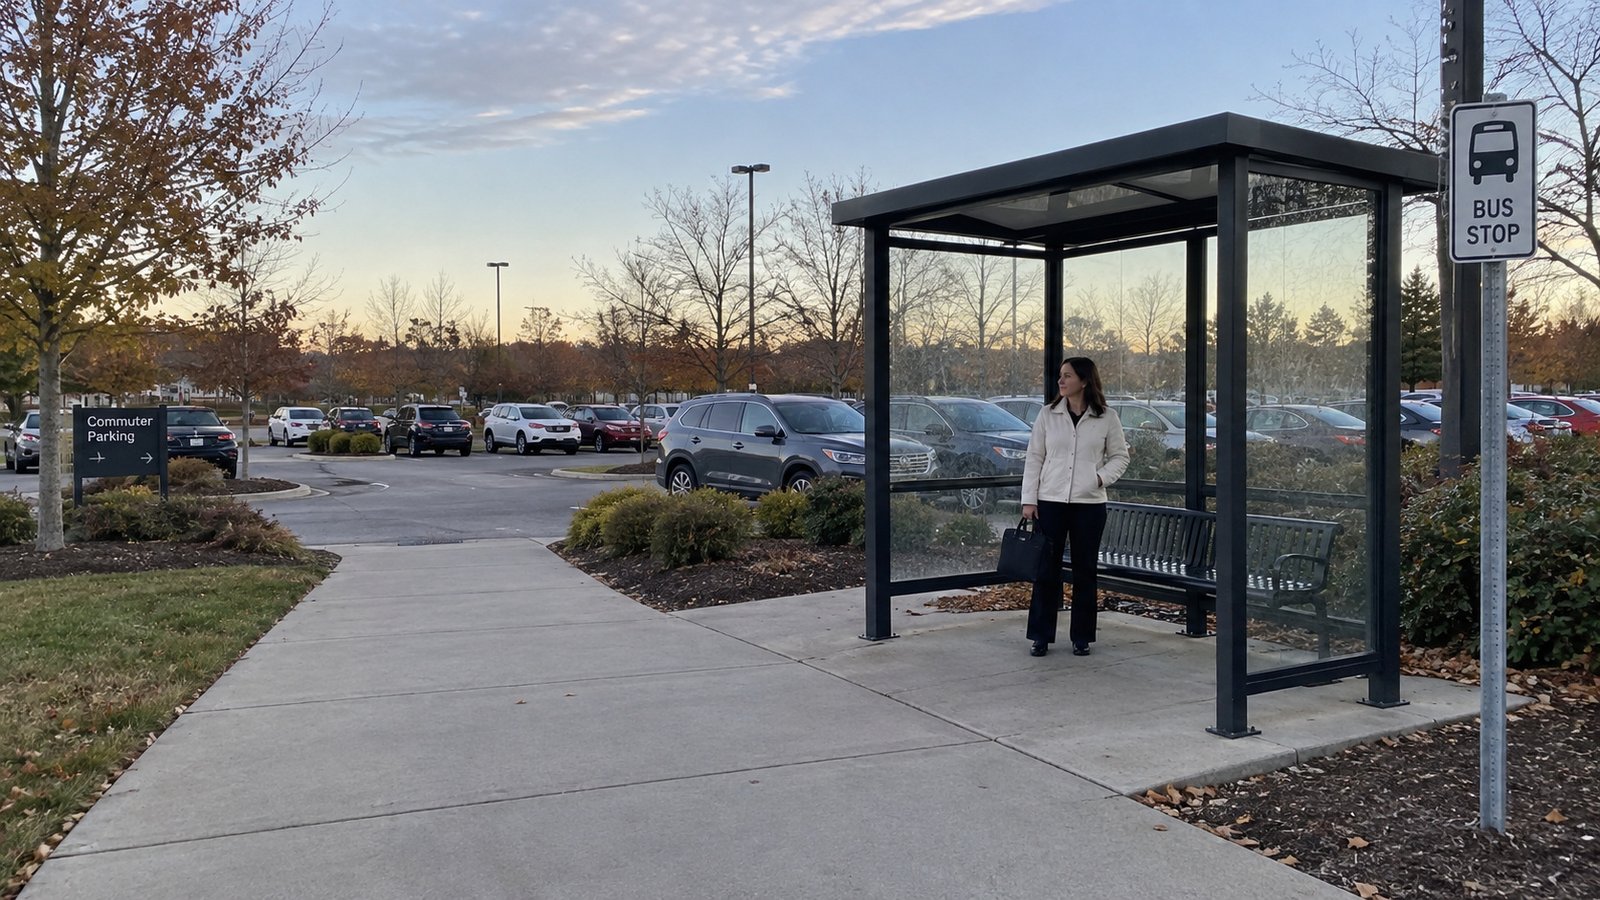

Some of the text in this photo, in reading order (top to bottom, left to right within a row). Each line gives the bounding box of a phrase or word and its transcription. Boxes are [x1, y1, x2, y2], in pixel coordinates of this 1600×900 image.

[1473, 198, 1513, 219] BUS
[1467, 224, 1520, 245] STOP
[87, 416, 153, 427] Commuter
[87, 431, 135, 444] Parking
